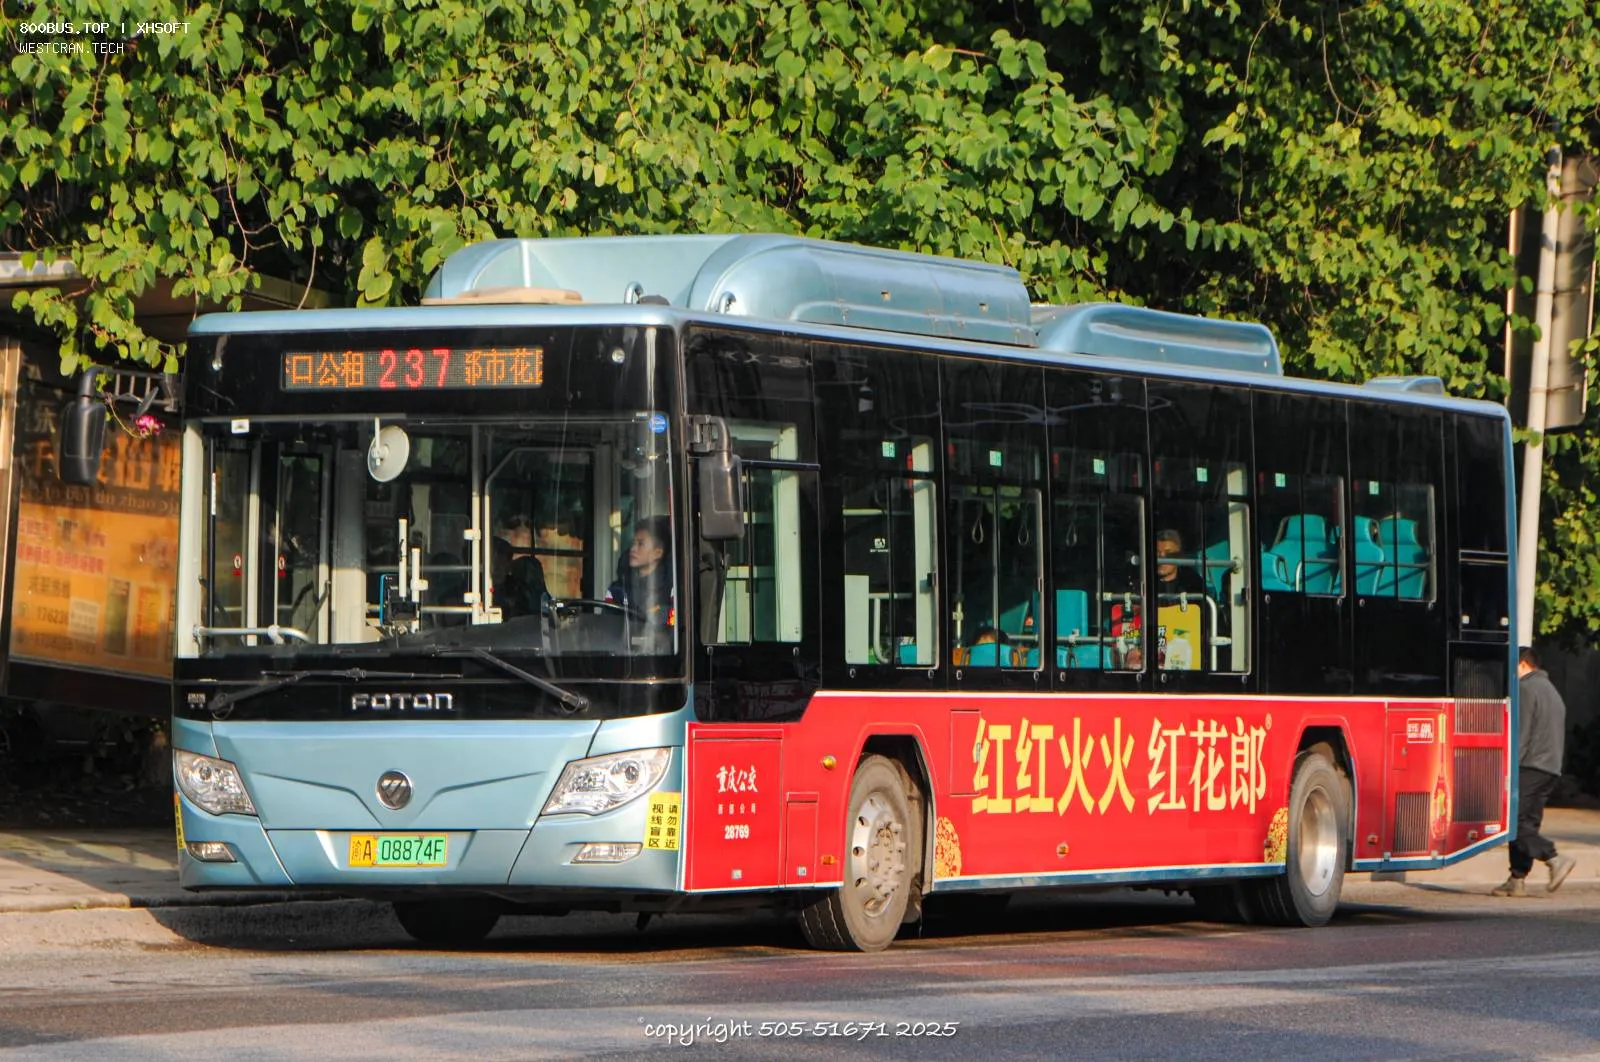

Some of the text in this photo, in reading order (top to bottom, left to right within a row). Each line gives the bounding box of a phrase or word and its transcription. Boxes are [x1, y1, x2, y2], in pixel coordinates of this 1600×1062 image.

[285, 351, 364, 387] 口公租
[379, 349, 450, 388] 237
[351, 693, 453, 710] FOTON
[716, 765, 758, 793] 重庆公交
[971, 716, 1267, 817] 红红火火 红花郎
[724, 824, 750, 840] 28769
